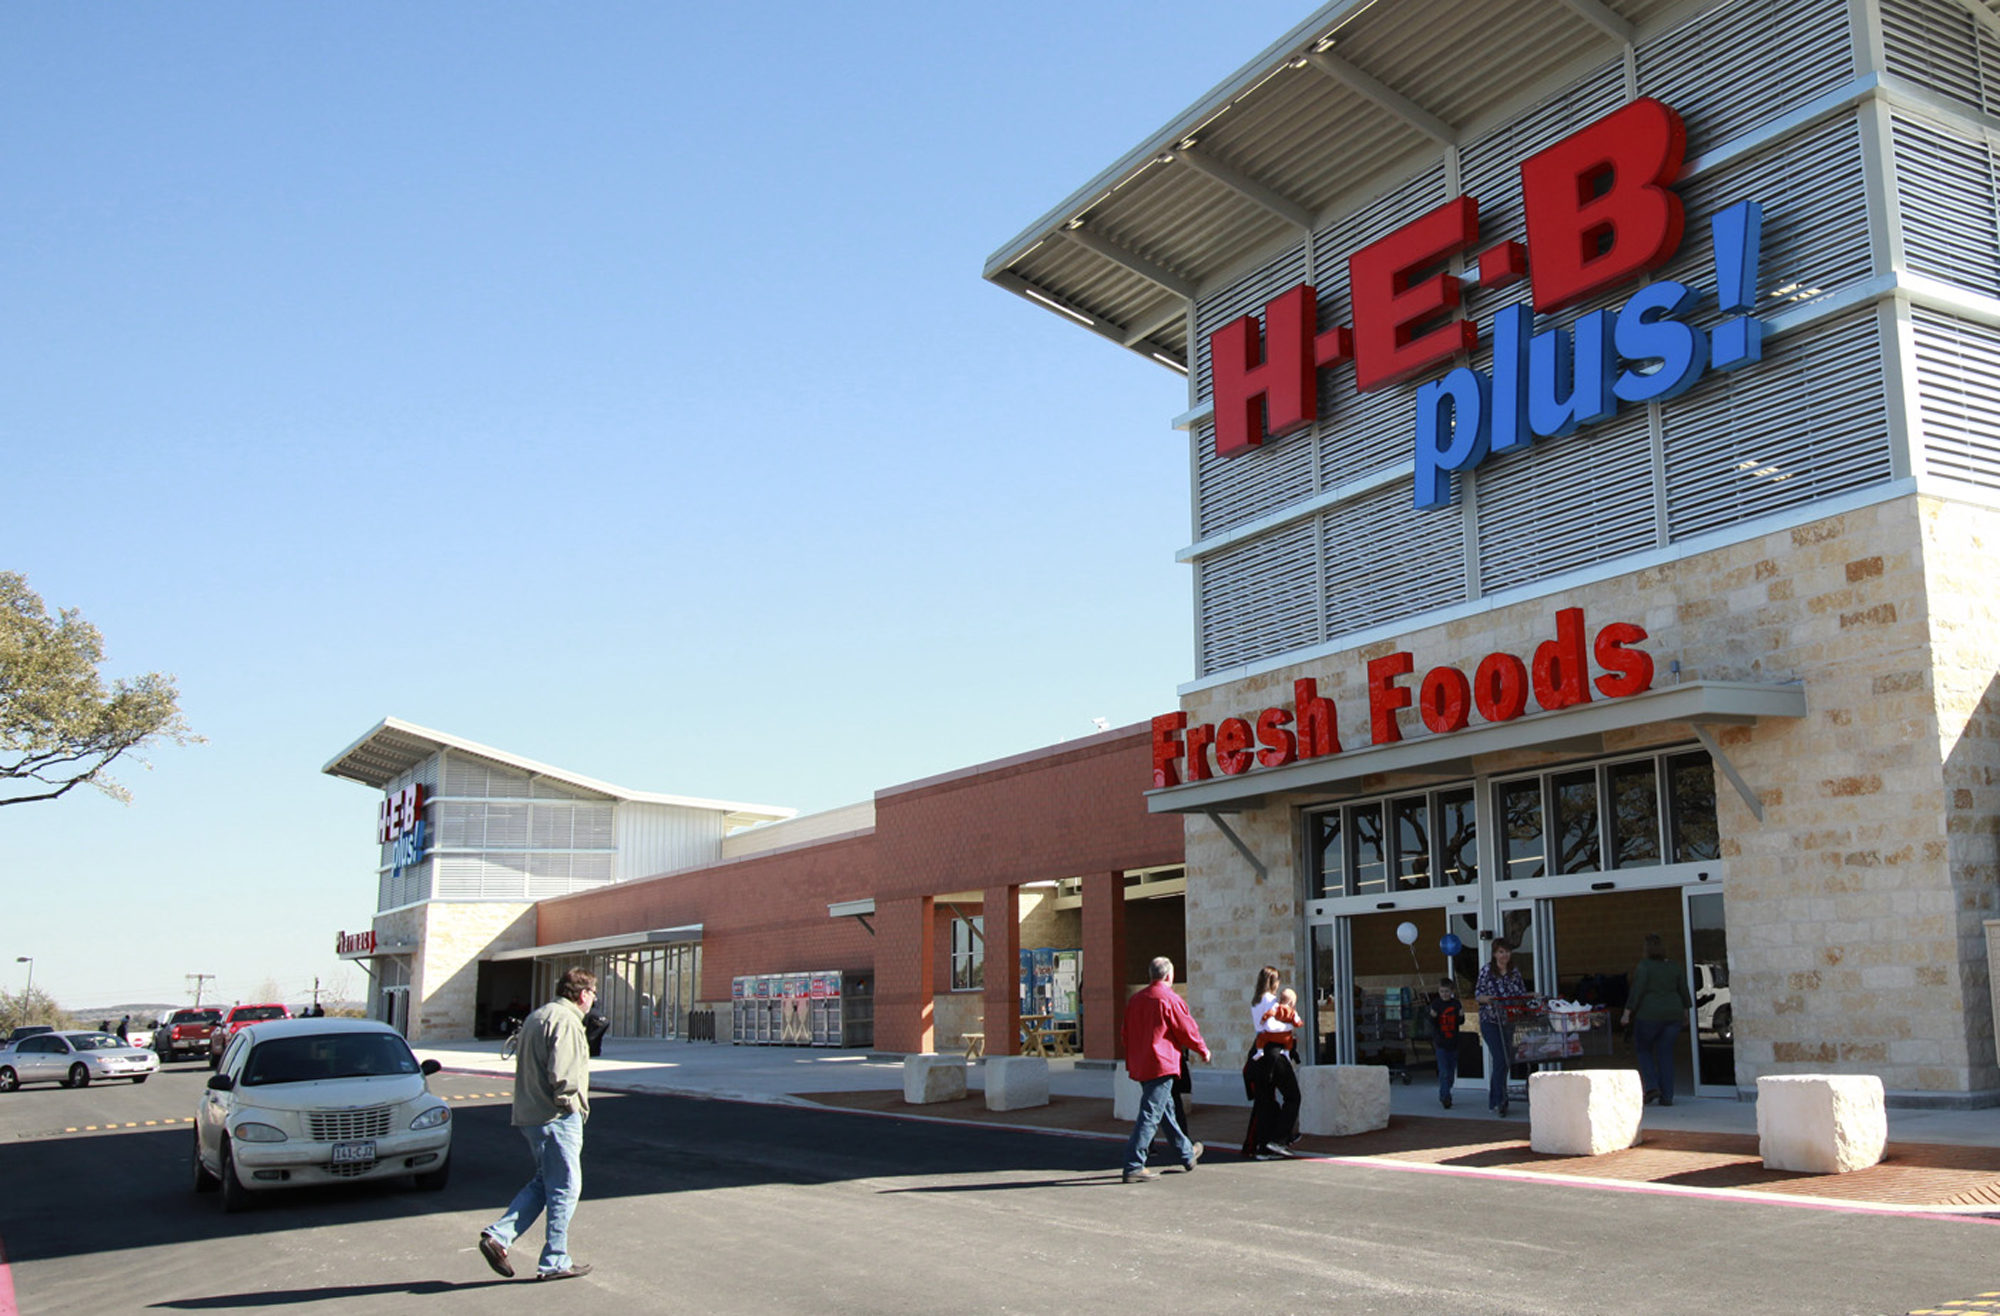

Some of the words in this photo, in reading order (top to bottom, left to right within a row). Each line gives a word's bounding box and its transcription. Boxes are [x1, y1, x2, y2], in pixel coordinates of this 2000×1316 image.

[1210, 97, 1686, 459] H-E-B
[1413, 200, 1763, 511] plus!
[1152, 677, 1342, 788] Fresh
[1367, 607, 1654, 745] Foods
